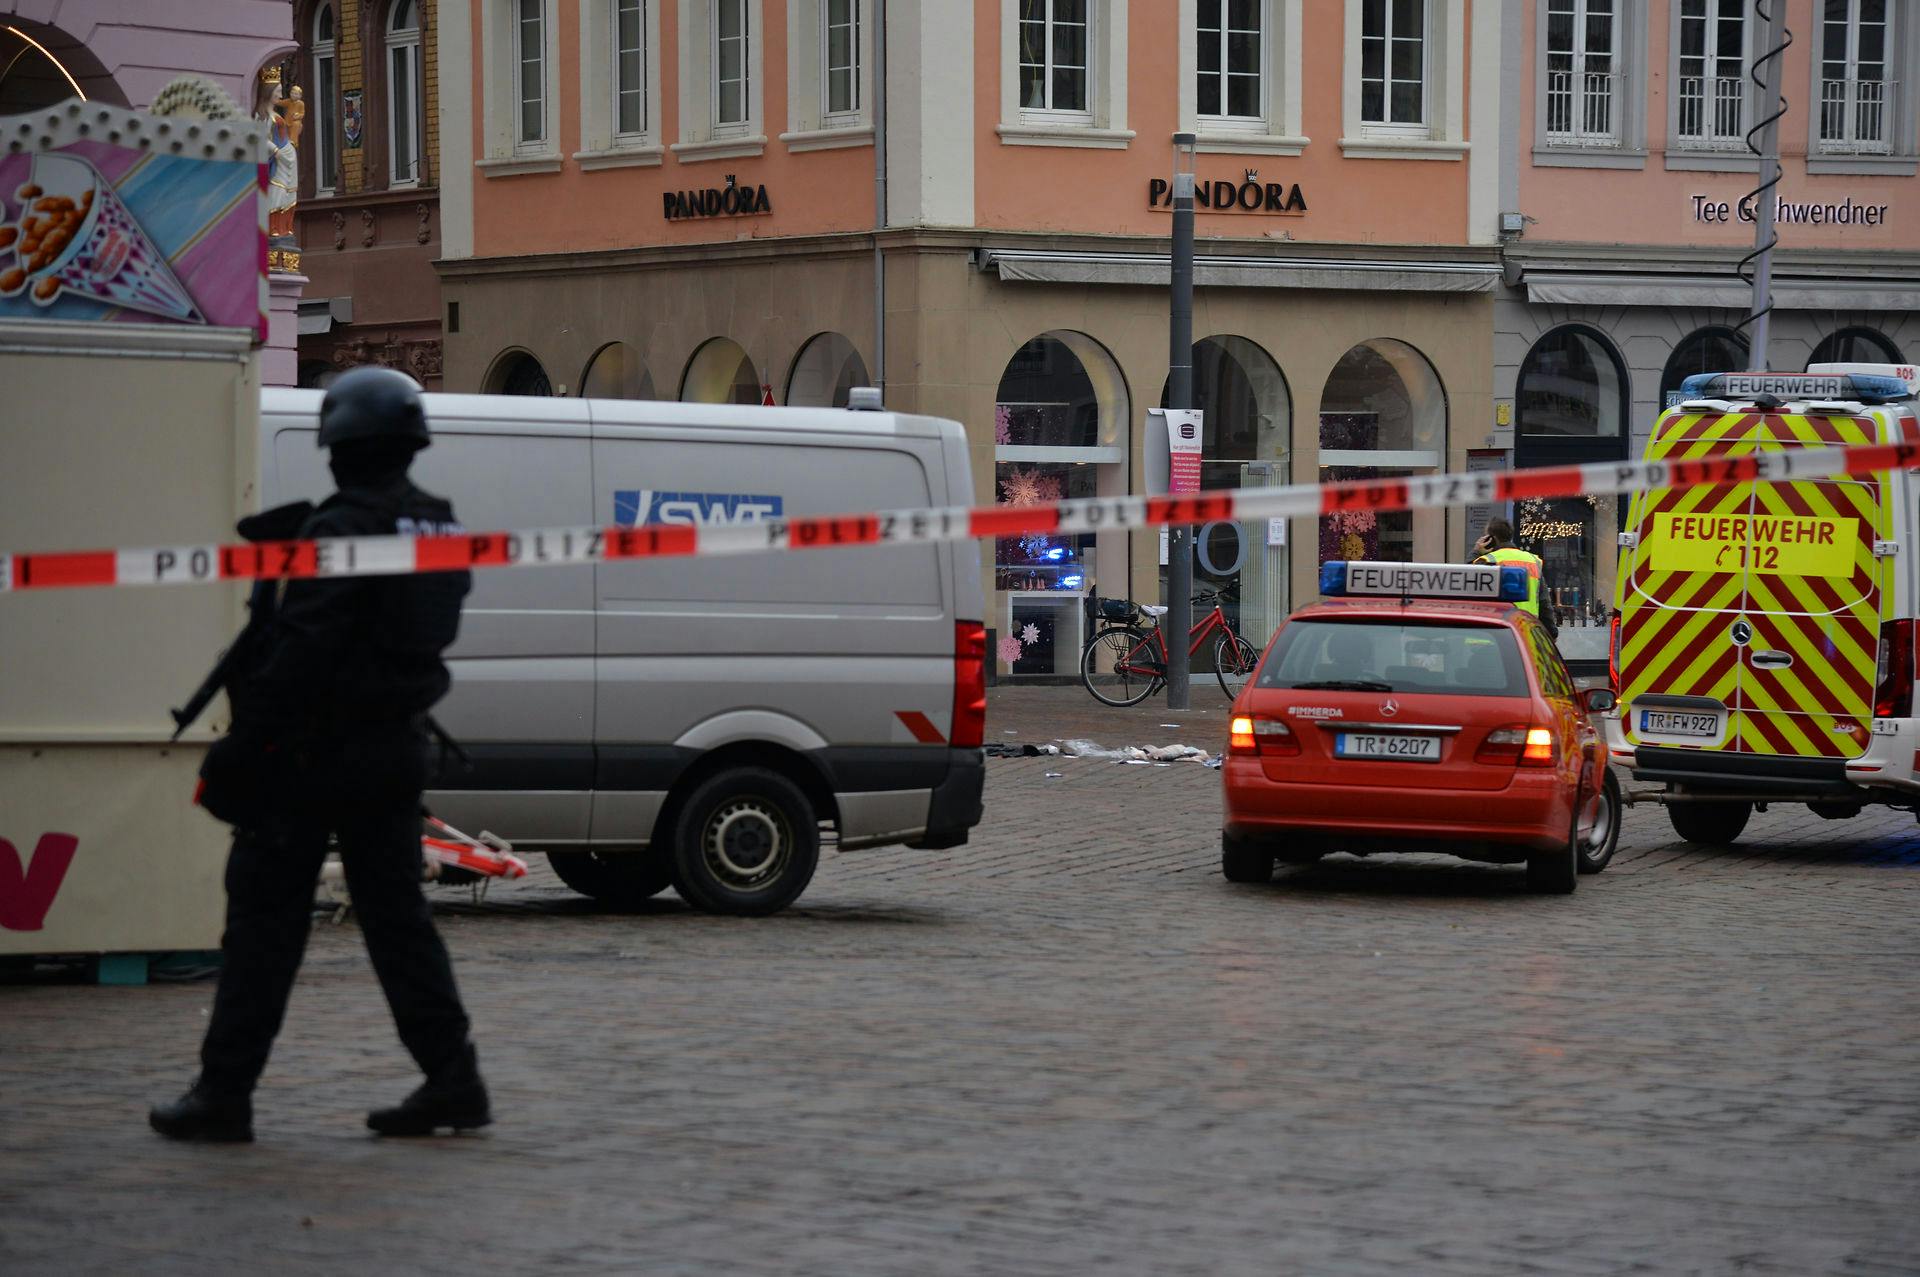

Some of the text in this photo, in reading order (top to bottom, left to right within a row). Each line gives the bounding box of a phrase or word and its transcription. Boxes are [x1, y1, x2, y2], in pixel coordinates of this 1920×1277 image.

[663, 184, 771, 219] PANDORA
[1149, 178, 1308, 211] PNDORA
[1692, 195, 1888, 225] Tee Ghwendner
[1729, 378, 1839, 394] FEUERWEHR
[155, 543, 357, 579] POLIZEI
[469, 530, 659, 563] POLIZEI
[767, 514, 949, 545] POLIZEI
[1616, 455, 1792, 485] POLIZEI
[1671, 517, 1835, 545] FEUERWEHR
[1738, 545, 1779, 569] 112
[1351, 569, 1494, 592] FEUERWEHR
[1288, 706, 1343, 718] #IMMERDA
[1650, 714, 1715, 731] TR FW 927
[1355, 736, 1430, 755] TR 6207
